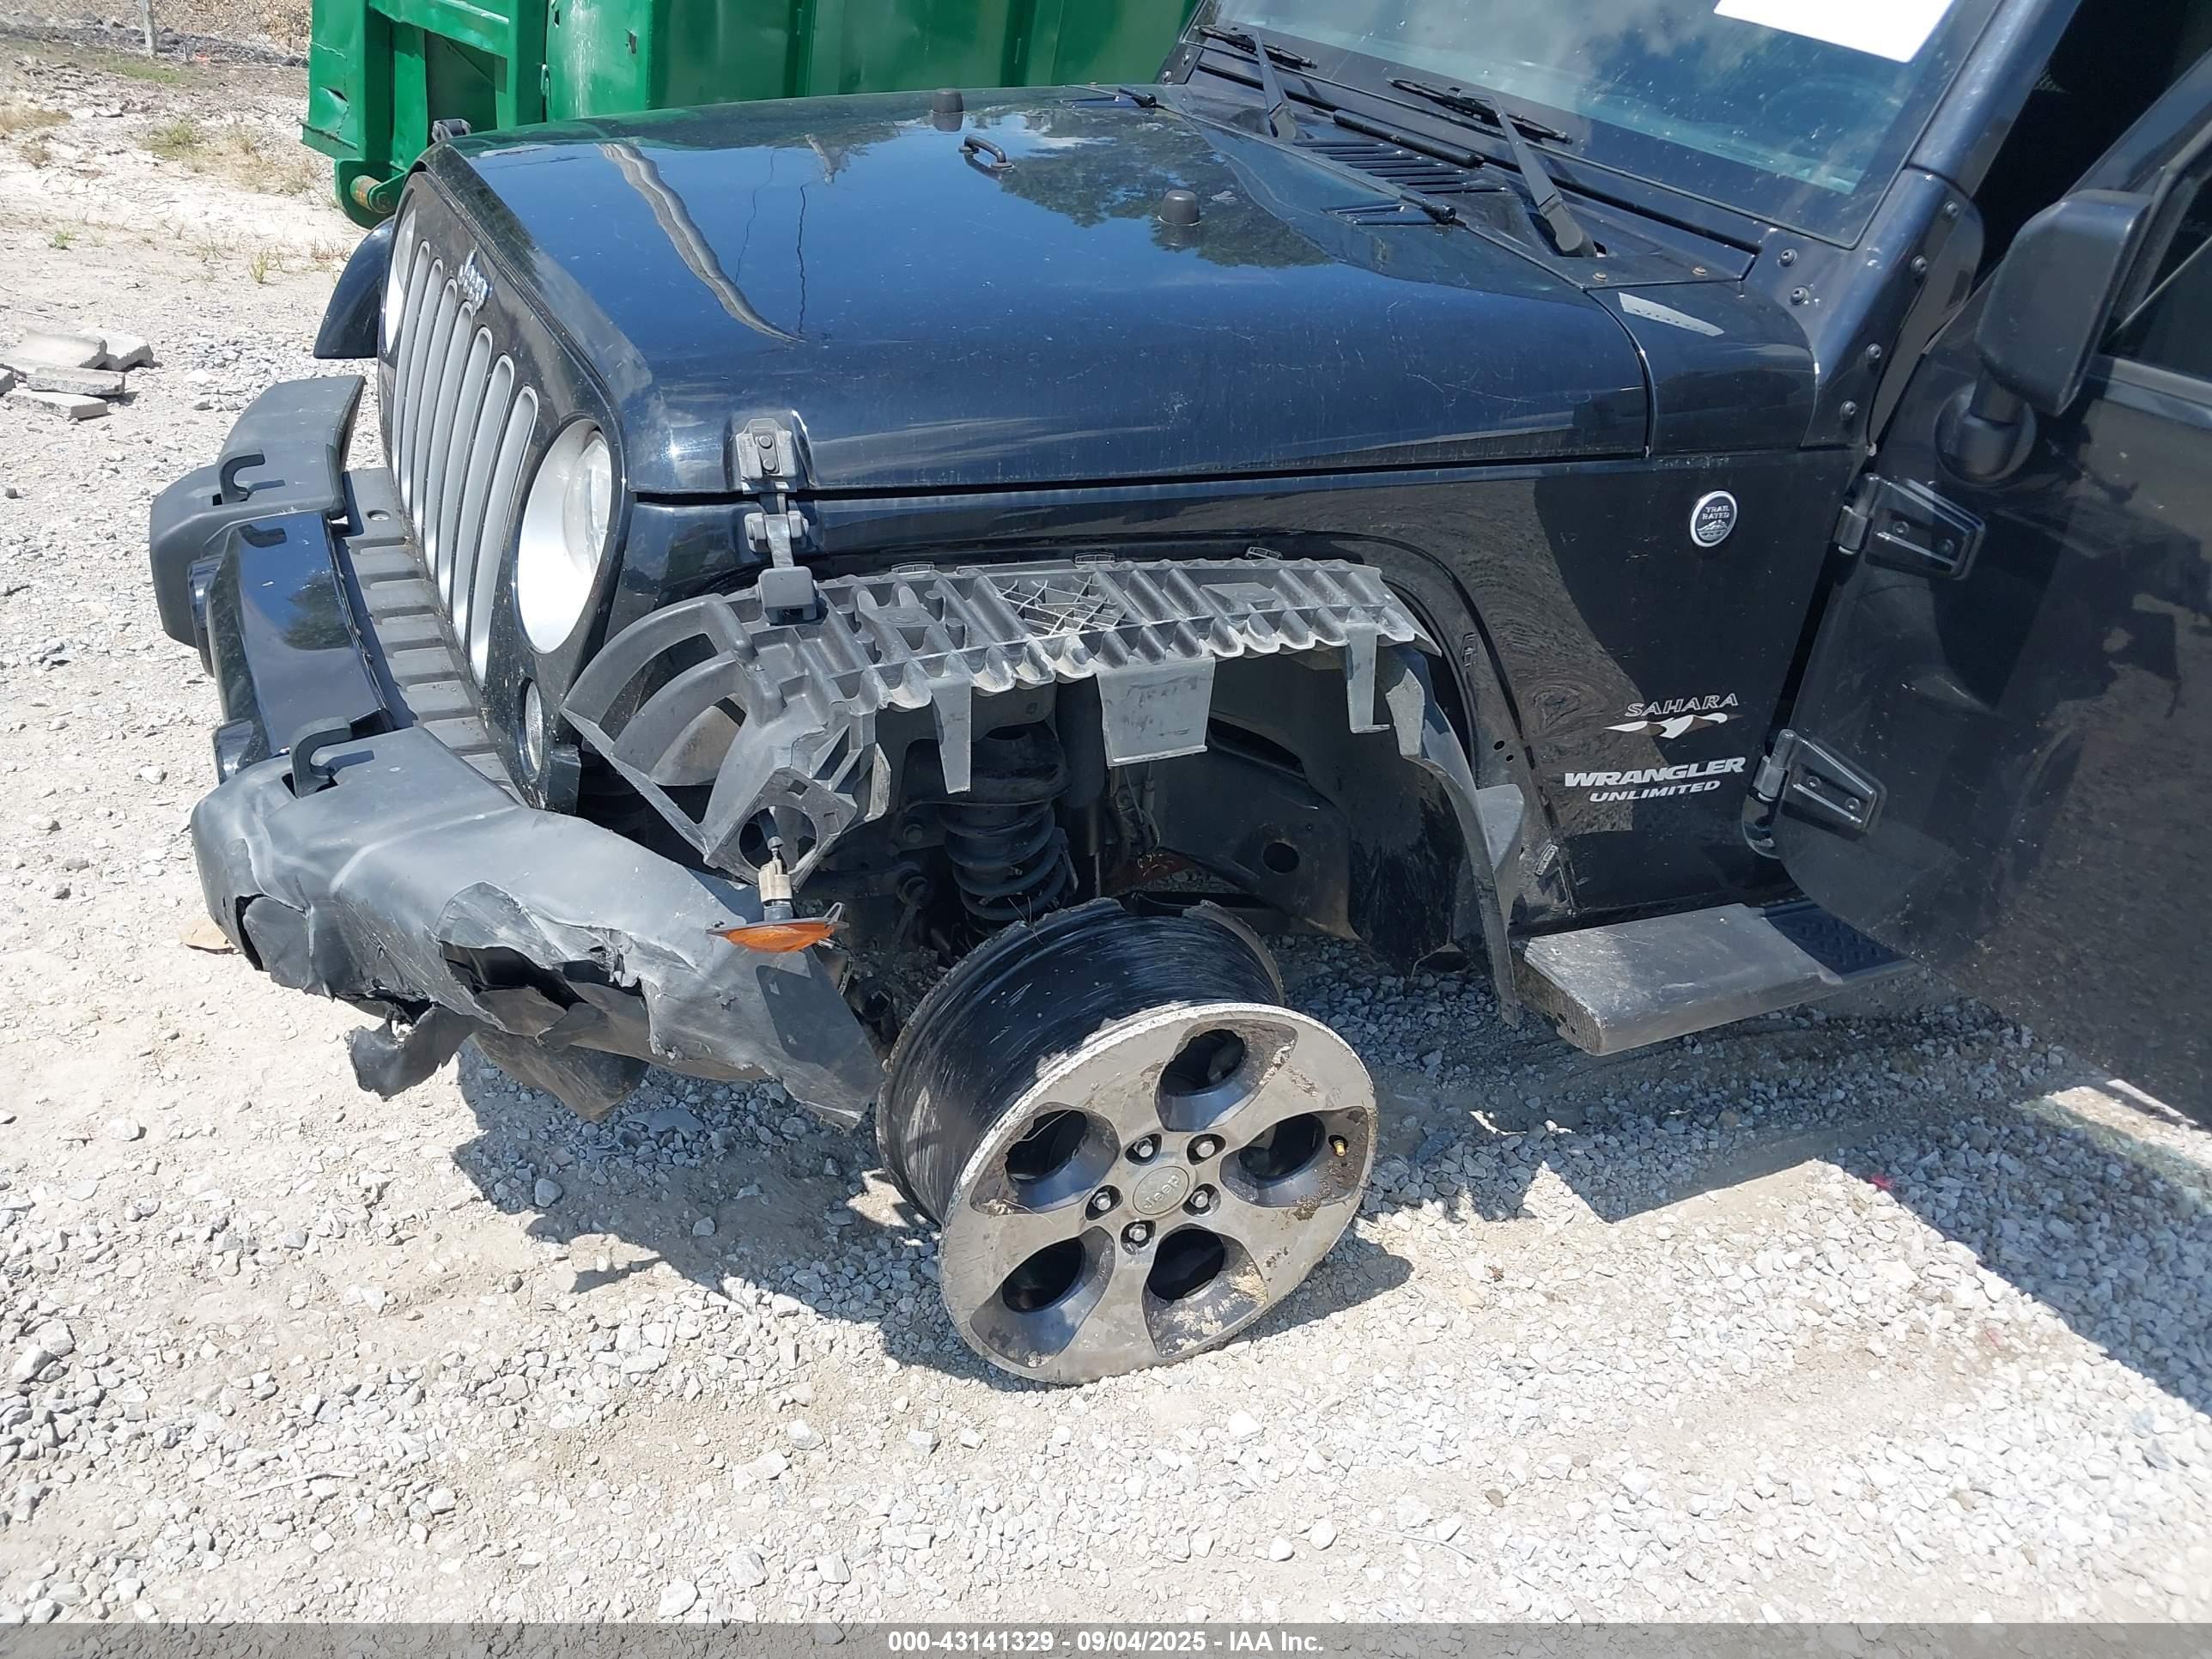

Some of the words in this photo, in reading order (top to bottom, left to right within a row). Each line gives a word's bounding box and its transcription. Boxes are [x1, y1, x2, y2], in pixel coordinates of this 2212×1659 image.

[1702, 512, 1730, 520] RATED
[1705, 505, 1730, 514] TRAIL
[1625, 692, 1739, 717] SAHARA
[1565, 757, 1747, 787] WRANGLER
[1589, 780, 1721, 803] UNLIMITED
[1144, 1175, 1181, 1210] Jeep
